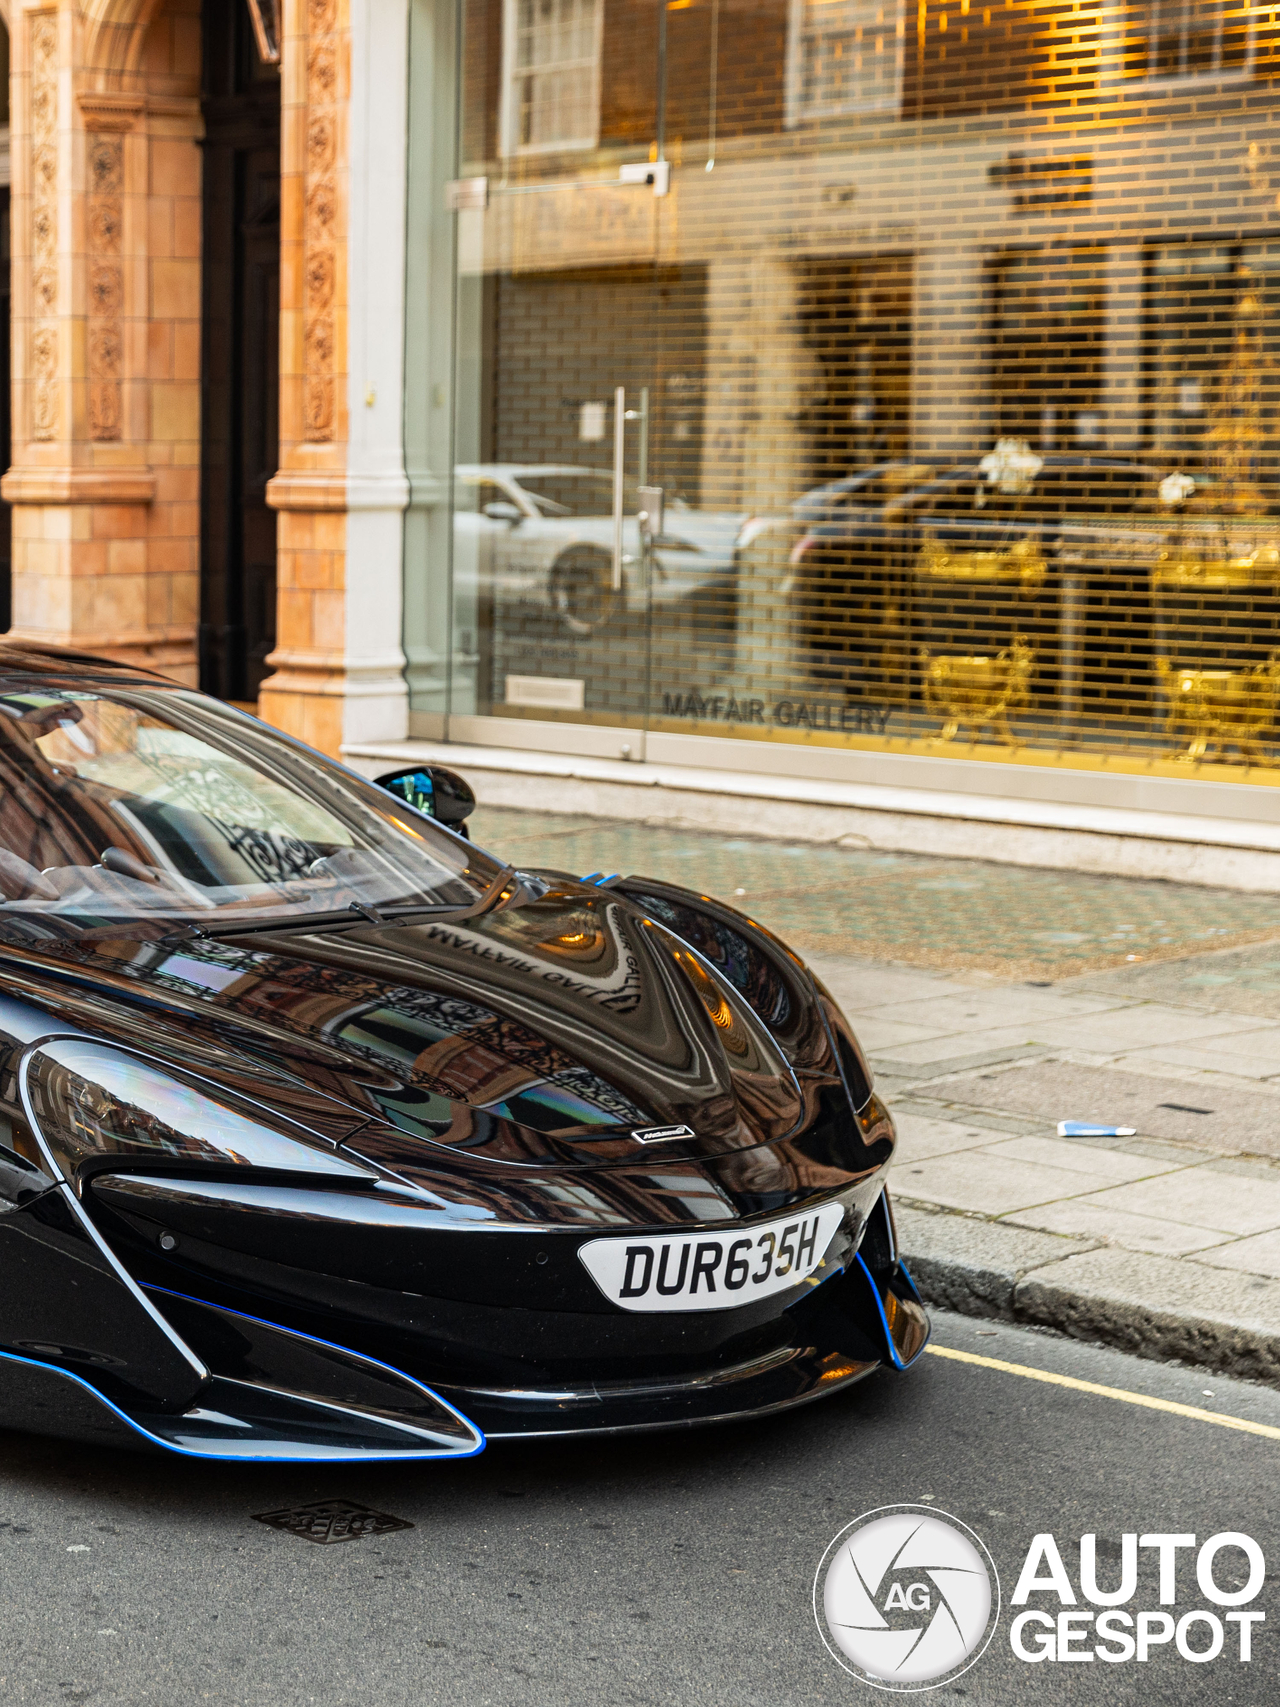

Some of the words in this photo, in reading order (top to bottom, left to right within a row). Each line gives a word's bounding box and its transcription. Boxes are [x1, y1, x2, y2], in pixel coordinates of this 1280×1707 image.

[663, 692, 766, 725] MAYFAIR
[772, 700, 892, 735] GALLERY
[619, 1216, 820, 1298] DUR635H
